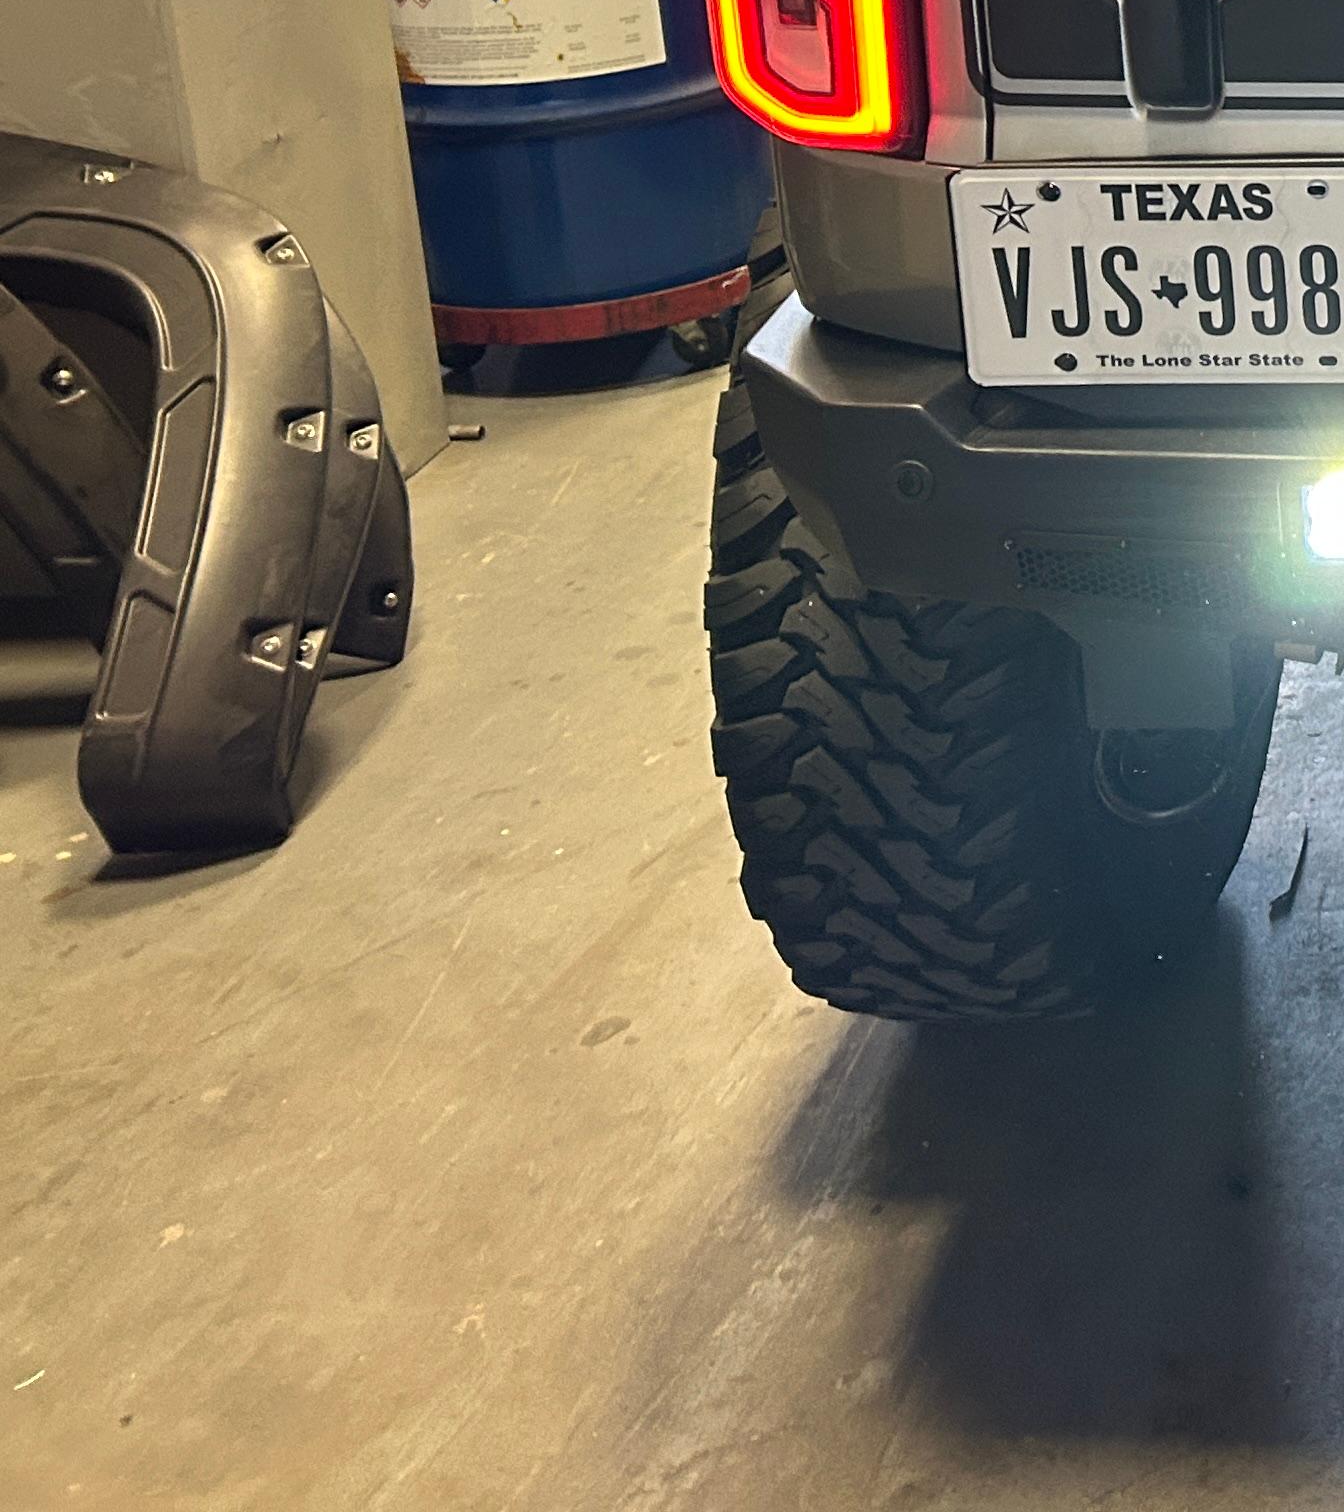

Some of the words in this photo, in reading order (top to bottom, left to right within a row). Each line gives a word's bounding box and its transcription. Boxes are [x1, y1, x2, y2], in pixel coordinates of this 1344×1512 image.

[1100, 182, 1274, 222] TEXAS
[1096, 354, 1135, 368] The
[1140, 354, 1193, 368] Lone
[1198, 353, 1244, 368] Star
[1248, 353, 1304, 367] State
